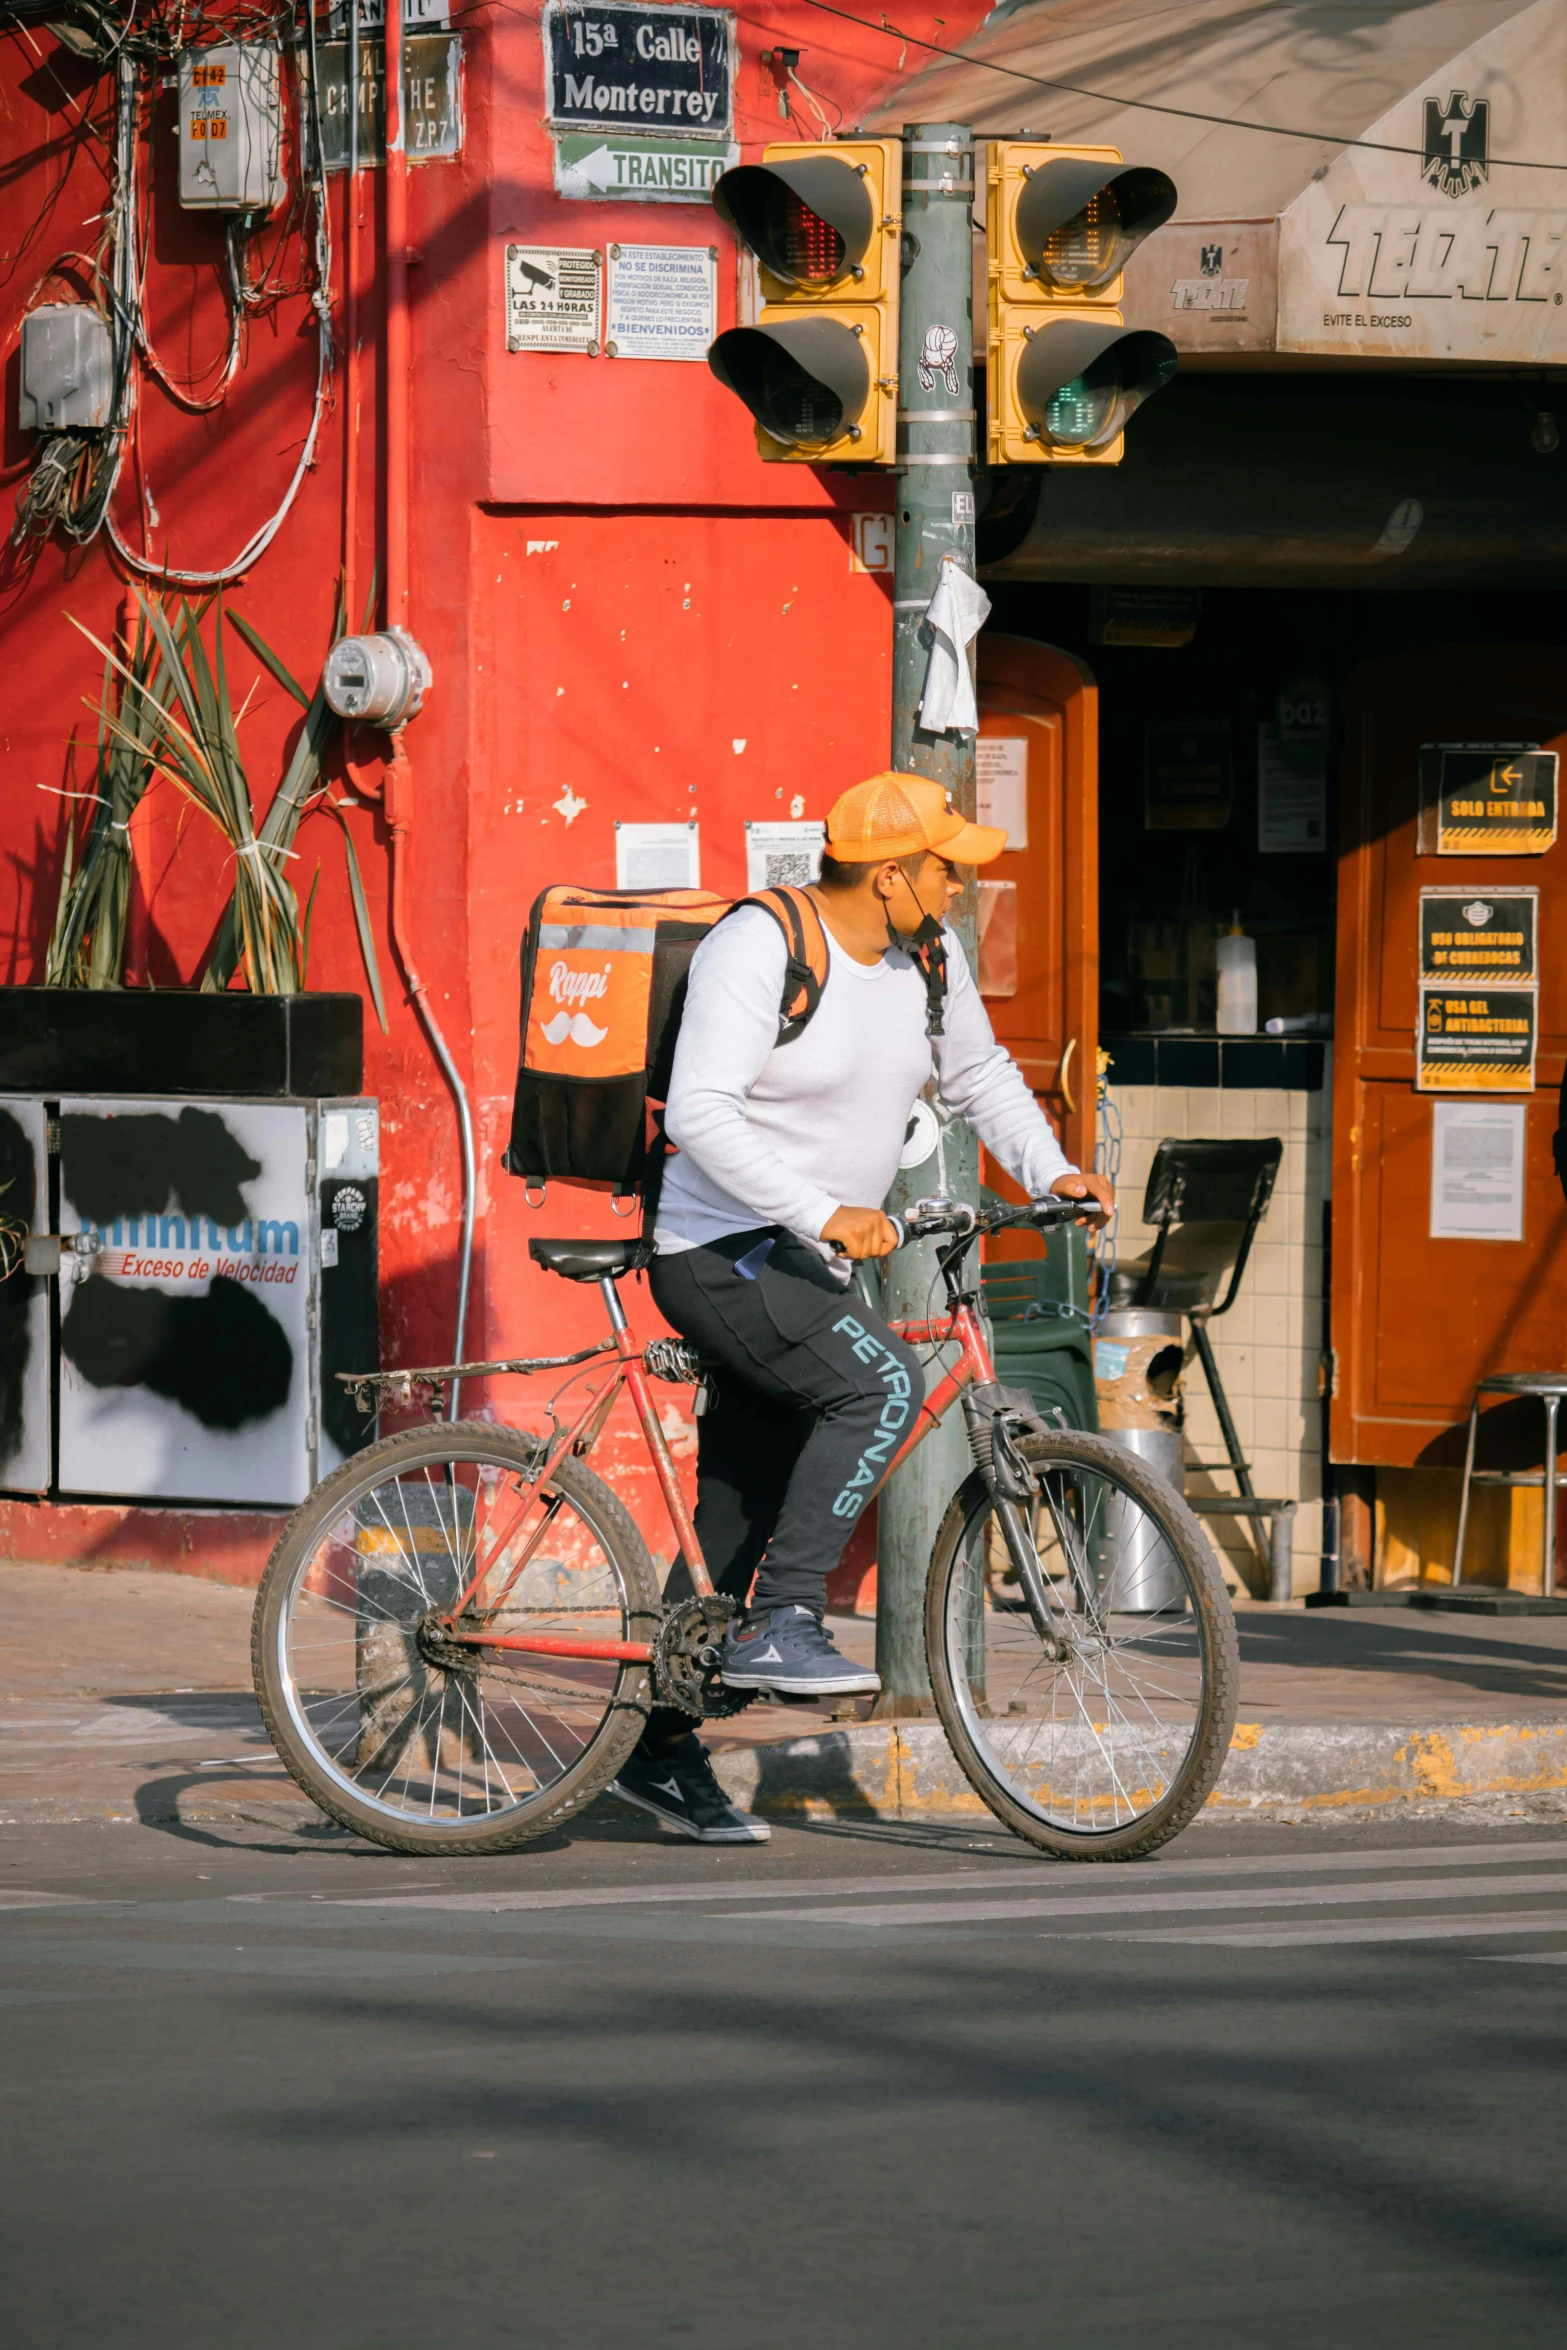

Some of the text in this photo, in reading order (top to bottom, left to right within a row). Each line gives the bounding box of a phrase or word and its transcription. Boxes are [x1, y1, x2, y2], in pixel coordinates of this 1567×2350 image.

[636, 25, 701, 62] Calle
[563, 74, 719, 122] Monterrey
[190, 110, 227, 120] TELMEX
[628, 252, 644, 260] ESTE
[645, 252, 704, 262] ESTABLECIMIENTO
[618, 262, 704, 275] NO SE DISCRIMINA
[1170, 279, 1250, 310] TECATE
[513, 300, 595, 313] LAS 24 HORAS
[1323, 313, 1412, 327] EVITE EL EXCESO
[1451, 800, 1546, 817] SOLO ENTRADA
[1431, 931, 1525, 946] USO OBLIGATORIO
[549, 961, 612, 1007] Rappi
[1469, 1000, 1489, 1014] GEL
[1445, 1018, 1530, 1033] ANTIBACTERIAL
[120, 1254, 299, 1284] Exceso de Velocidad
[831, 1314, 912, 1520] PETRONAS
